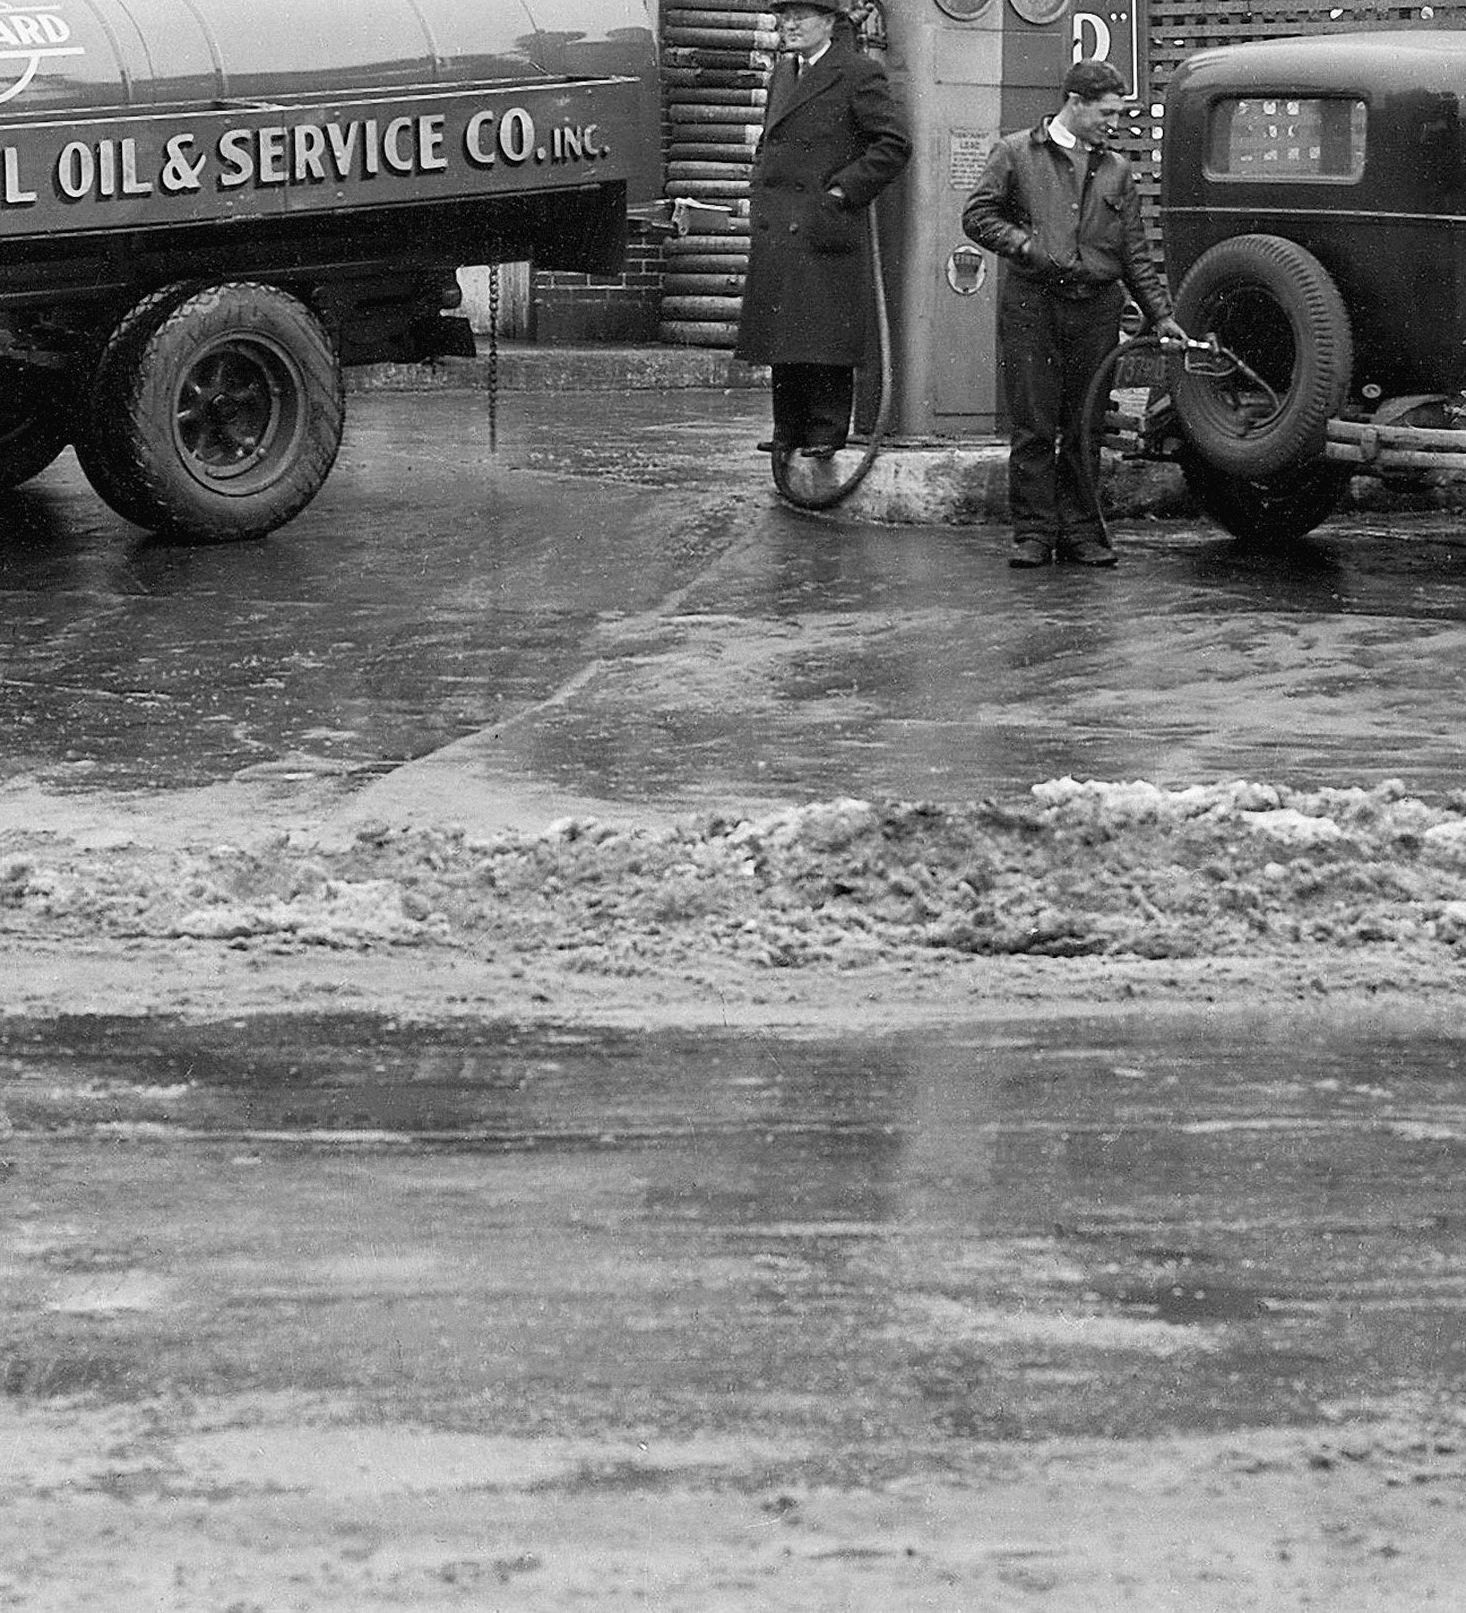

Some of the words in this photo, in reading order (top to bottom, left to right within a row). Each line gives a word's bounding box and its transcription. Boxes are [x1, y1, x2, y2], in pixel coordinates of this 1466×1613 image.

[57, 138, 154, 199] OIL
[162, 133, 207, 192] &
[217, 113, 449, 186] SERVICE
[464, 107, 547, 165] CO.
[553, 124, 611, 159] INC.
